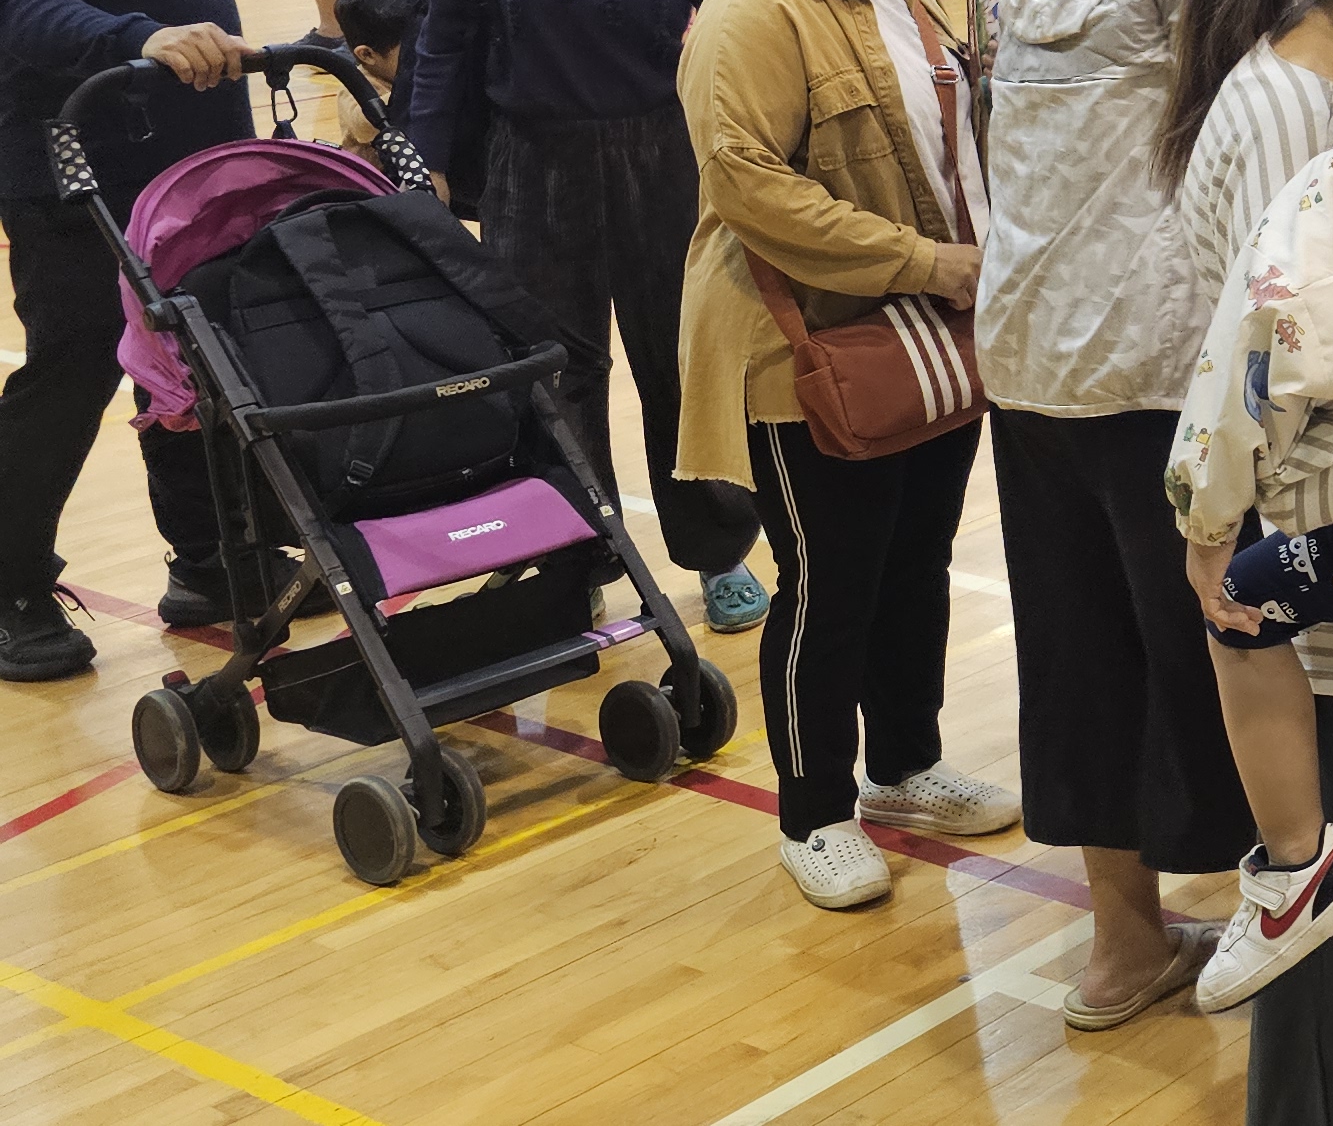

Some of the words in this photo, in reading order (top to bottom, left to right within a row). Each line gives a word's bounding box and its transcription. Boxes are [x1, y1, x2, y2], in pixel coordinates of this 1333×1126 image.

[436, 377, 490, 397] RECARO
[448, 520, 505, 541] RECARO
[1308, 538, 1320, 561] YOU
[1280, 601, 1299, 619] YOU
